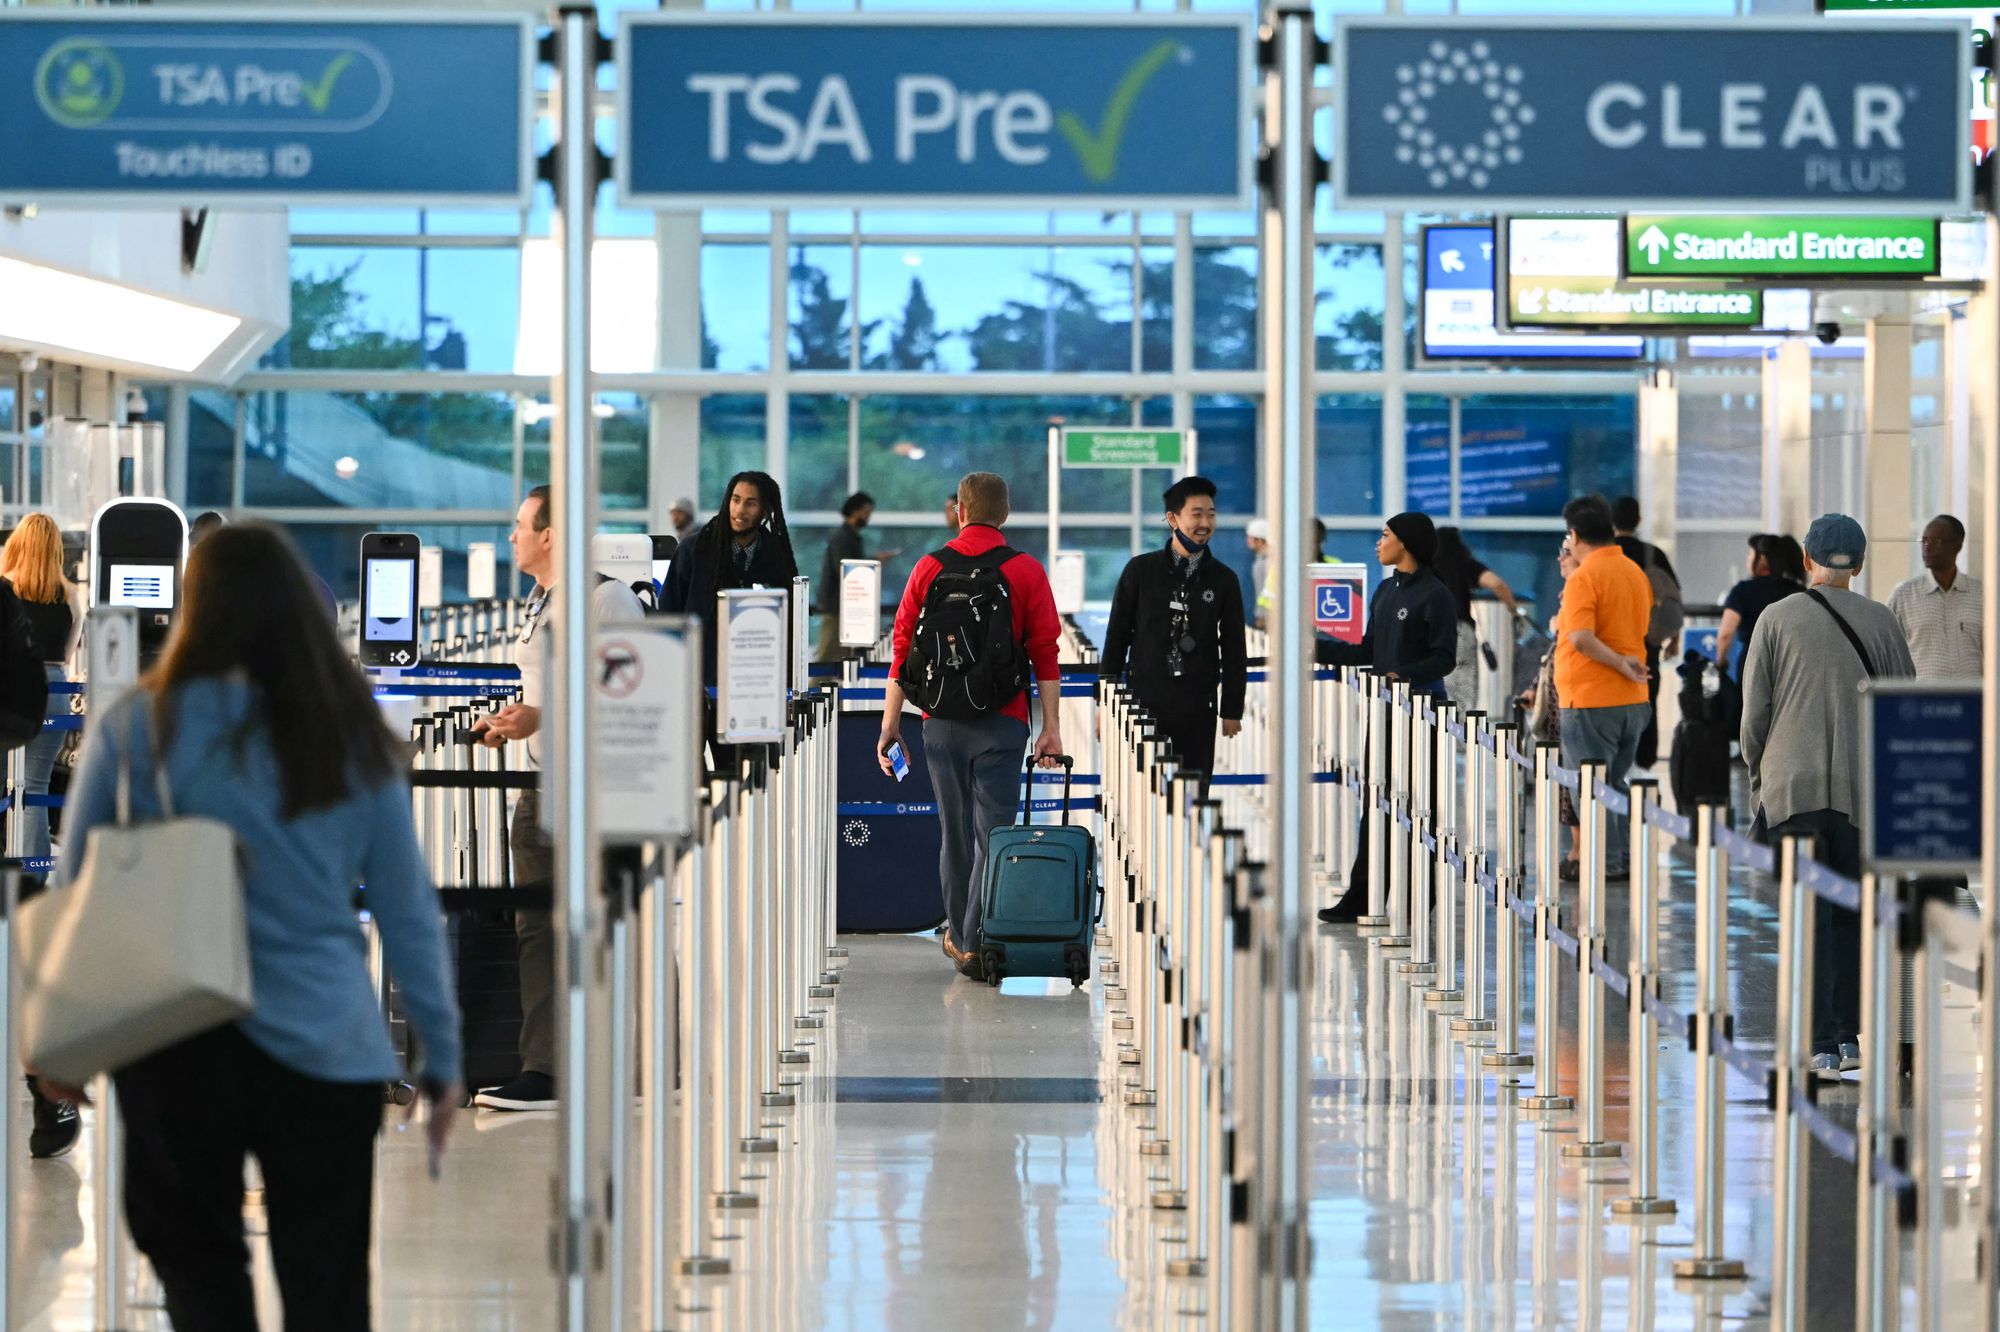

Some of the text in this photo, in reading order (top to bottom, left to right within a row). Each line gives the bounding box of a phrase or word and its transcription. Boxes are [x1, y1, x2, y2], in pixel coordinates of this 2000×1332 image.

[154, 64, 303, 106] TSA Pre
[687, 73, 1054, 165] TSA Pre
[1586, 82, 1905, 150] CLEAR
[115, 142, 311, 178] Touchless ID
[1805, 157, 1905, 191] PLUS
[1673, 231, 1925, 261] Standard Entrance
[1546, 289, 1752, 314] Standard Entrance
[1091, 433, 1157, 449] Standard
